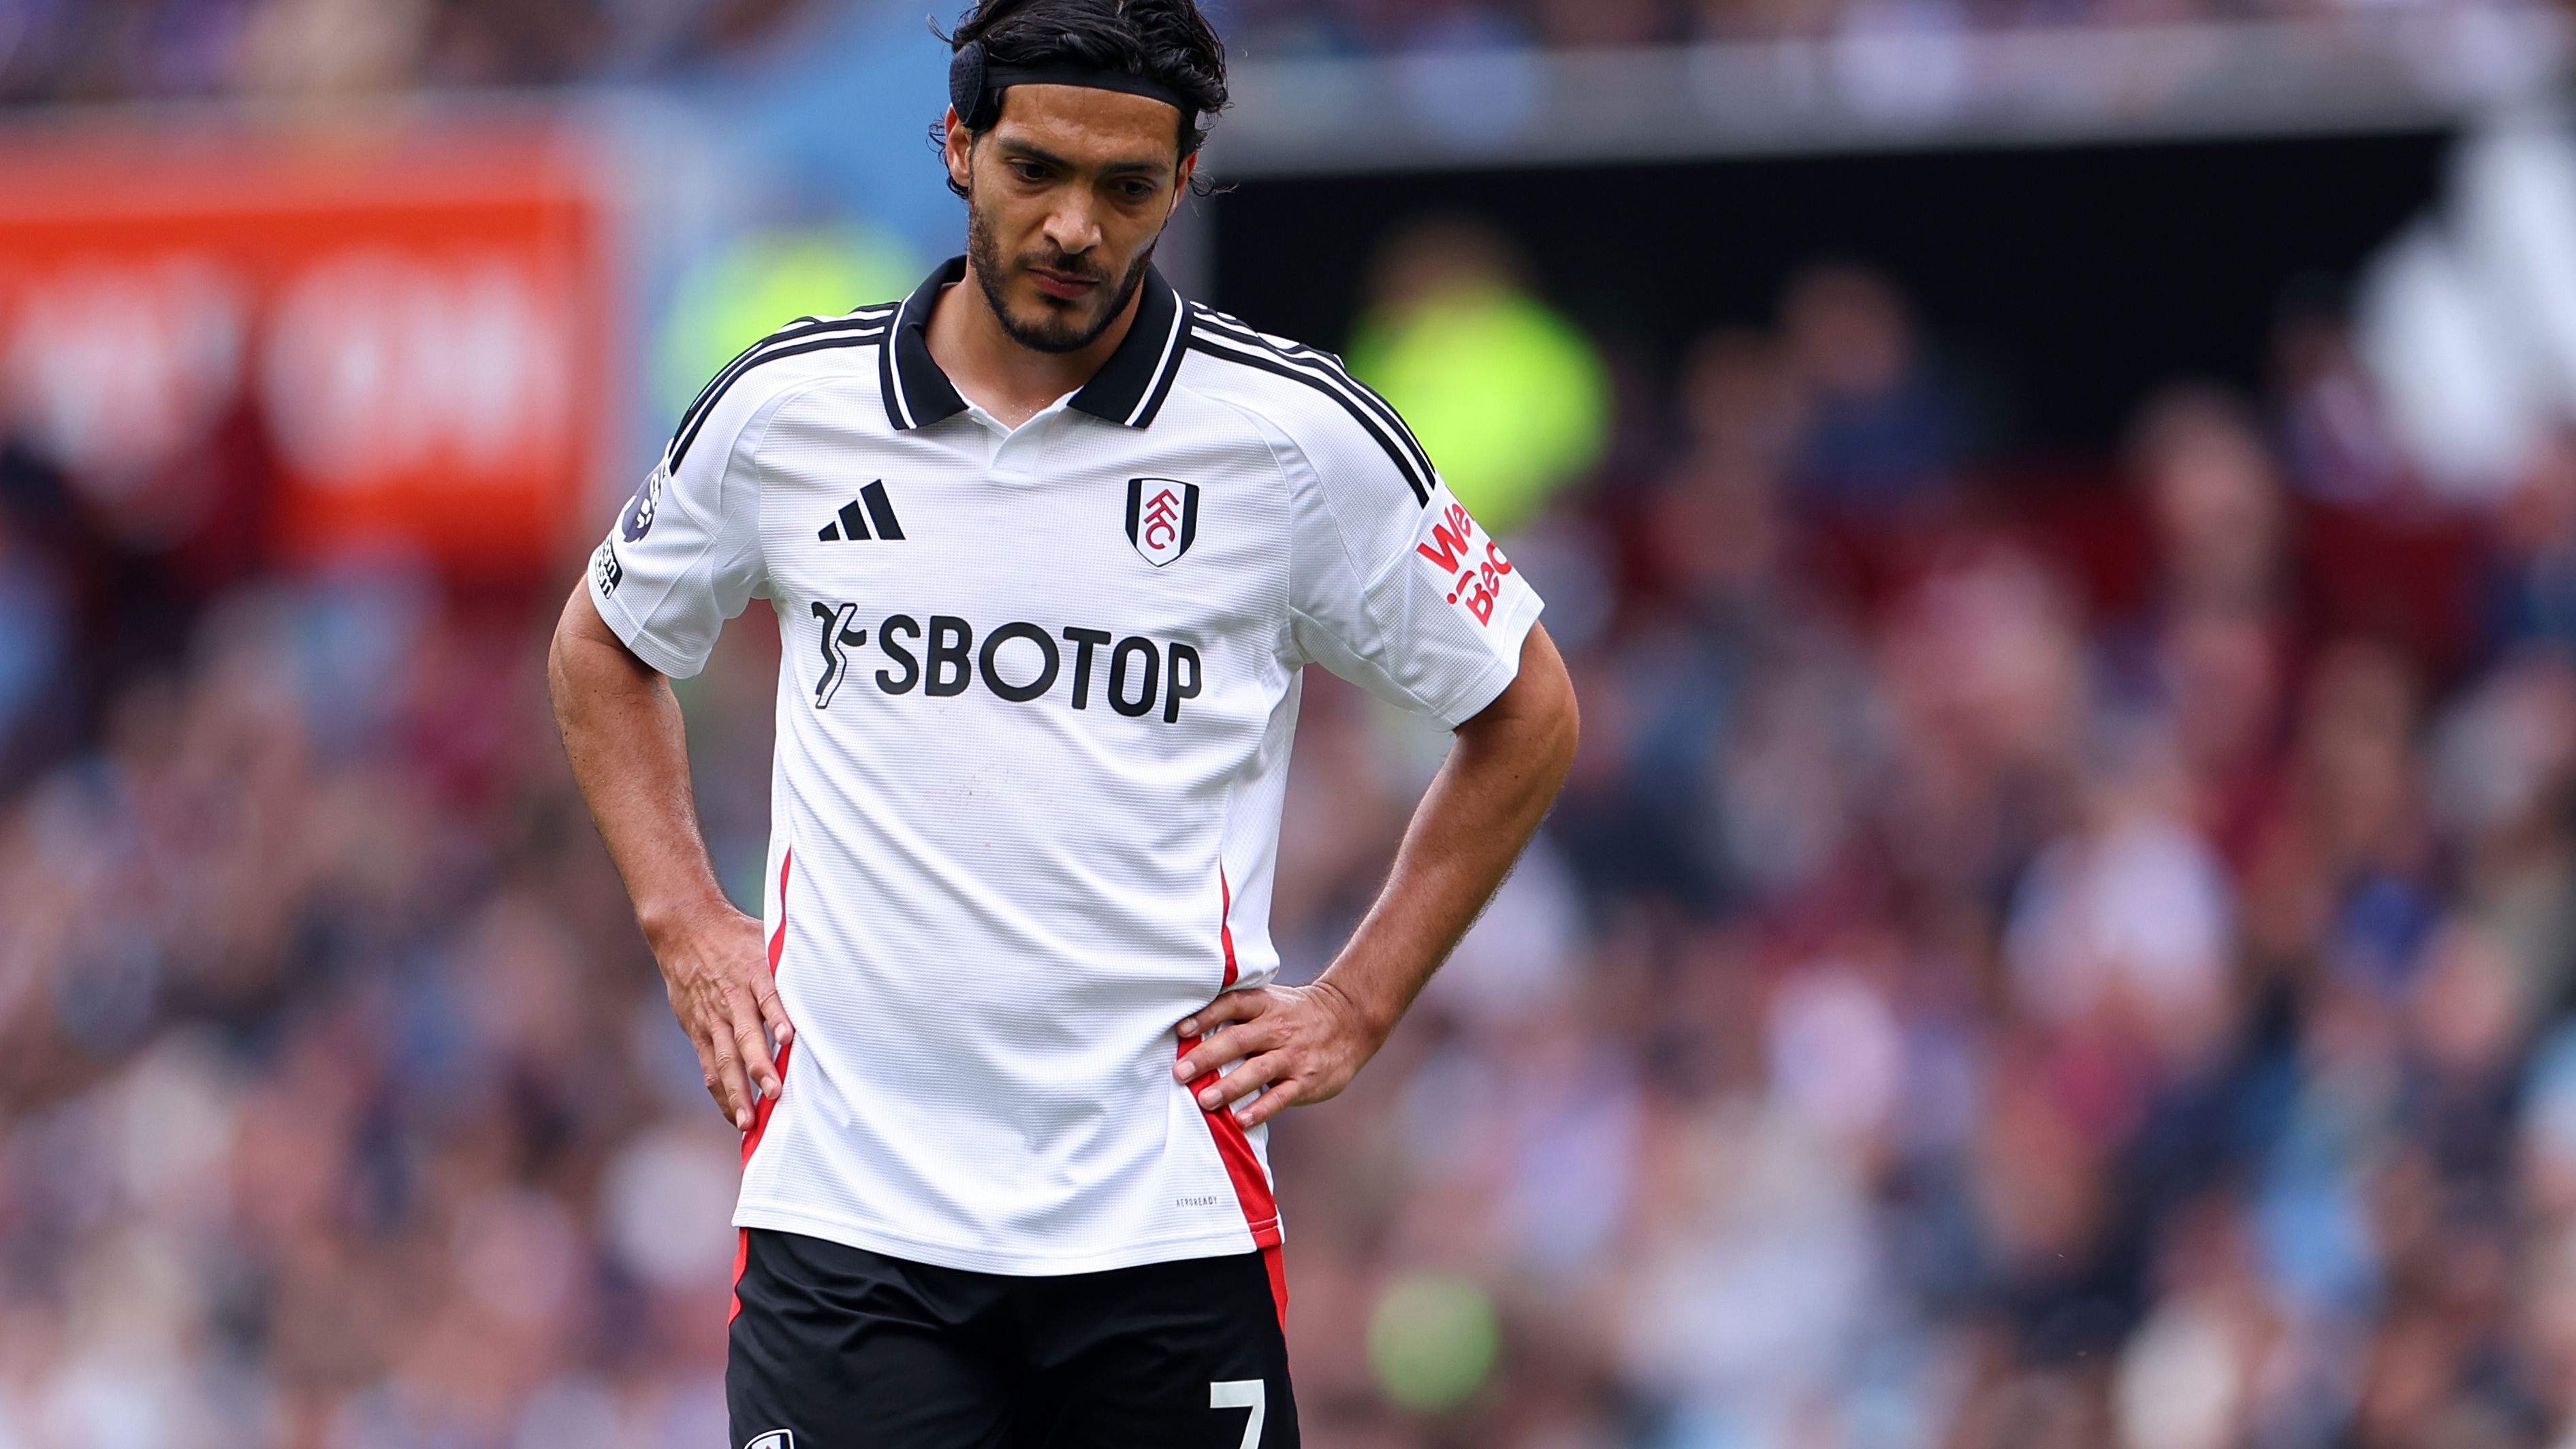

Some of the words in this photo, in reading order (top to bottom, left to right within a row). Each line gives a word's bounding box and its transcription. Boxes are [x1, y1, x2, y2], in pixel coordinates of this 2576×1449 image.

[1416, 501, 1473, 575] We
[876, 614, 1201, 723] SBOTOP
[1176, 1196, 1217, 1207] AEROREADY
[1209, 1379, 1265, 1449] 7
